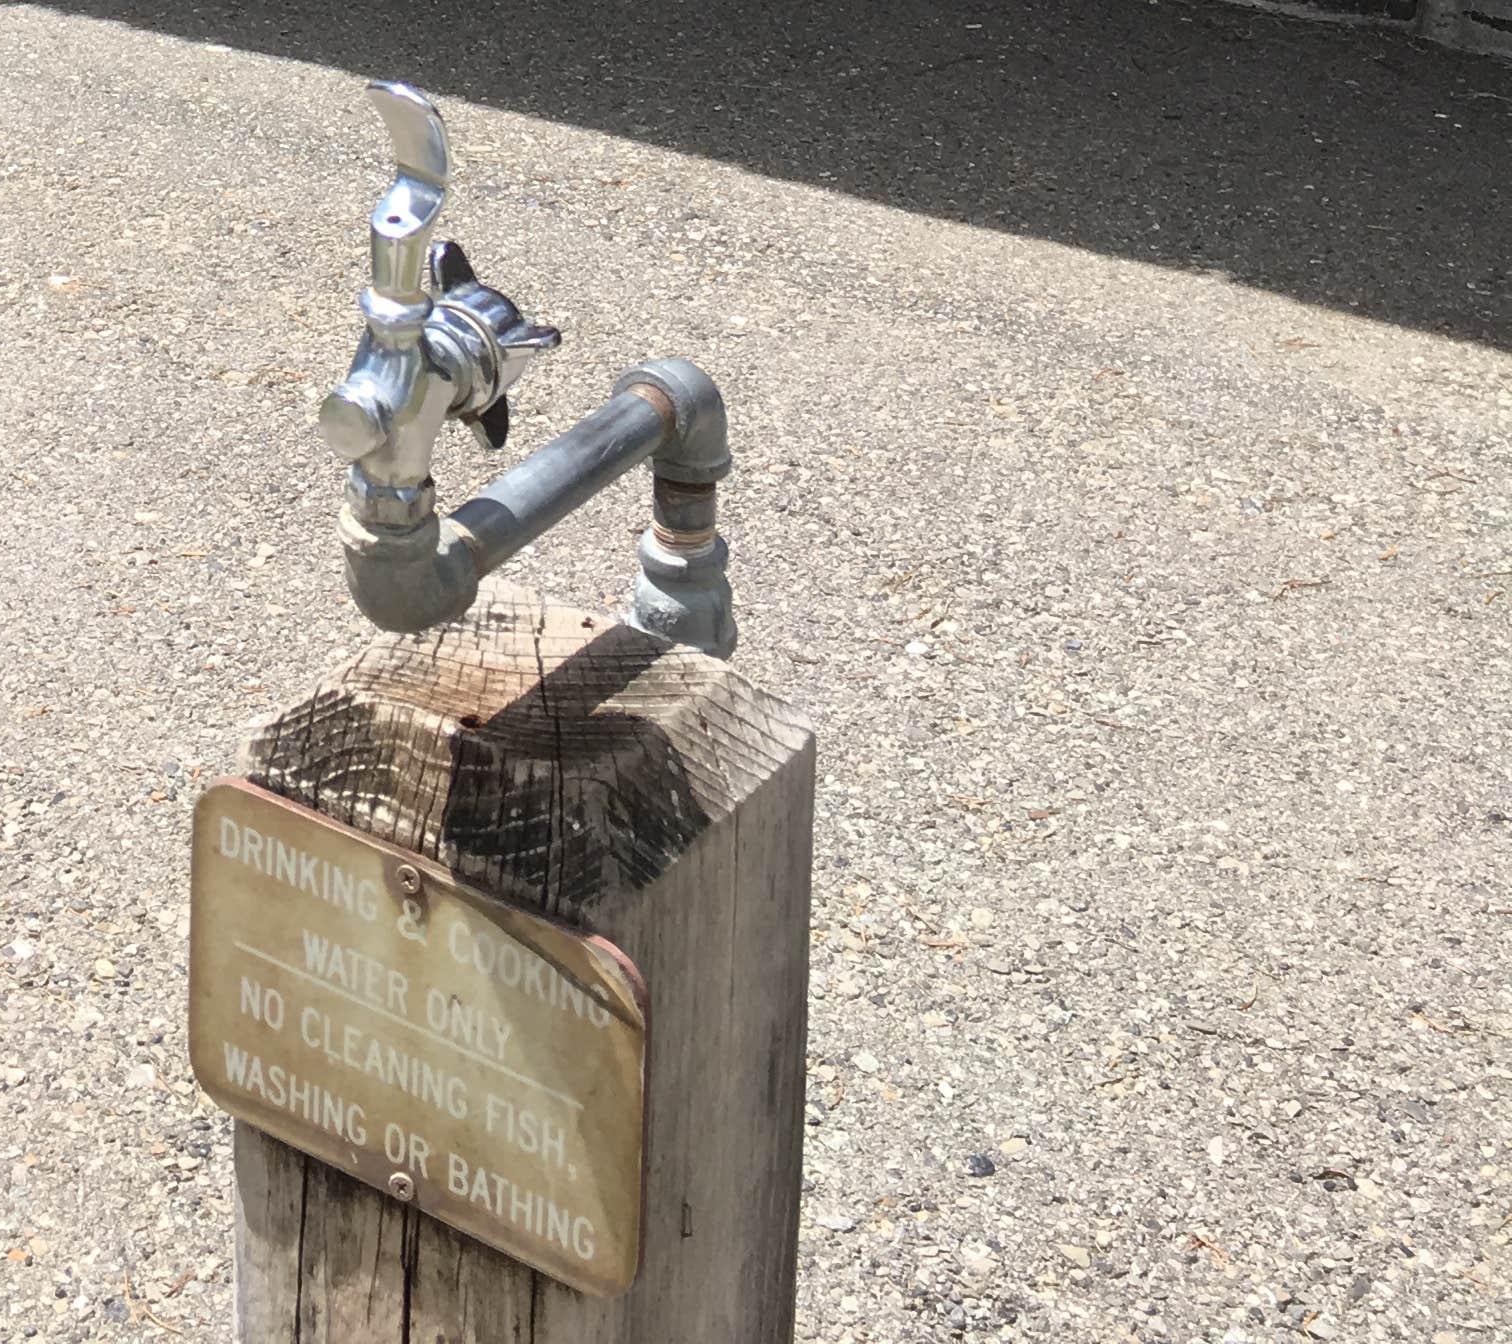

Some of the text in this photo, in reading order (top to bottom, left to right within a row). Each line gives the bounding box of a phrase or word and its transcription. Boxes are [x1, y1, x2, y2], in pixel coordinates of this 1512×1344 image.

[219, 816, 612, 1029] DRINKING & COOKING
[302, 928, 514, 1061] WATER ONLY
[223, 1041, 596, 1261] WASHING OR BATHING
[240, 976, 579, 1181] NO CLEANING FISH,
